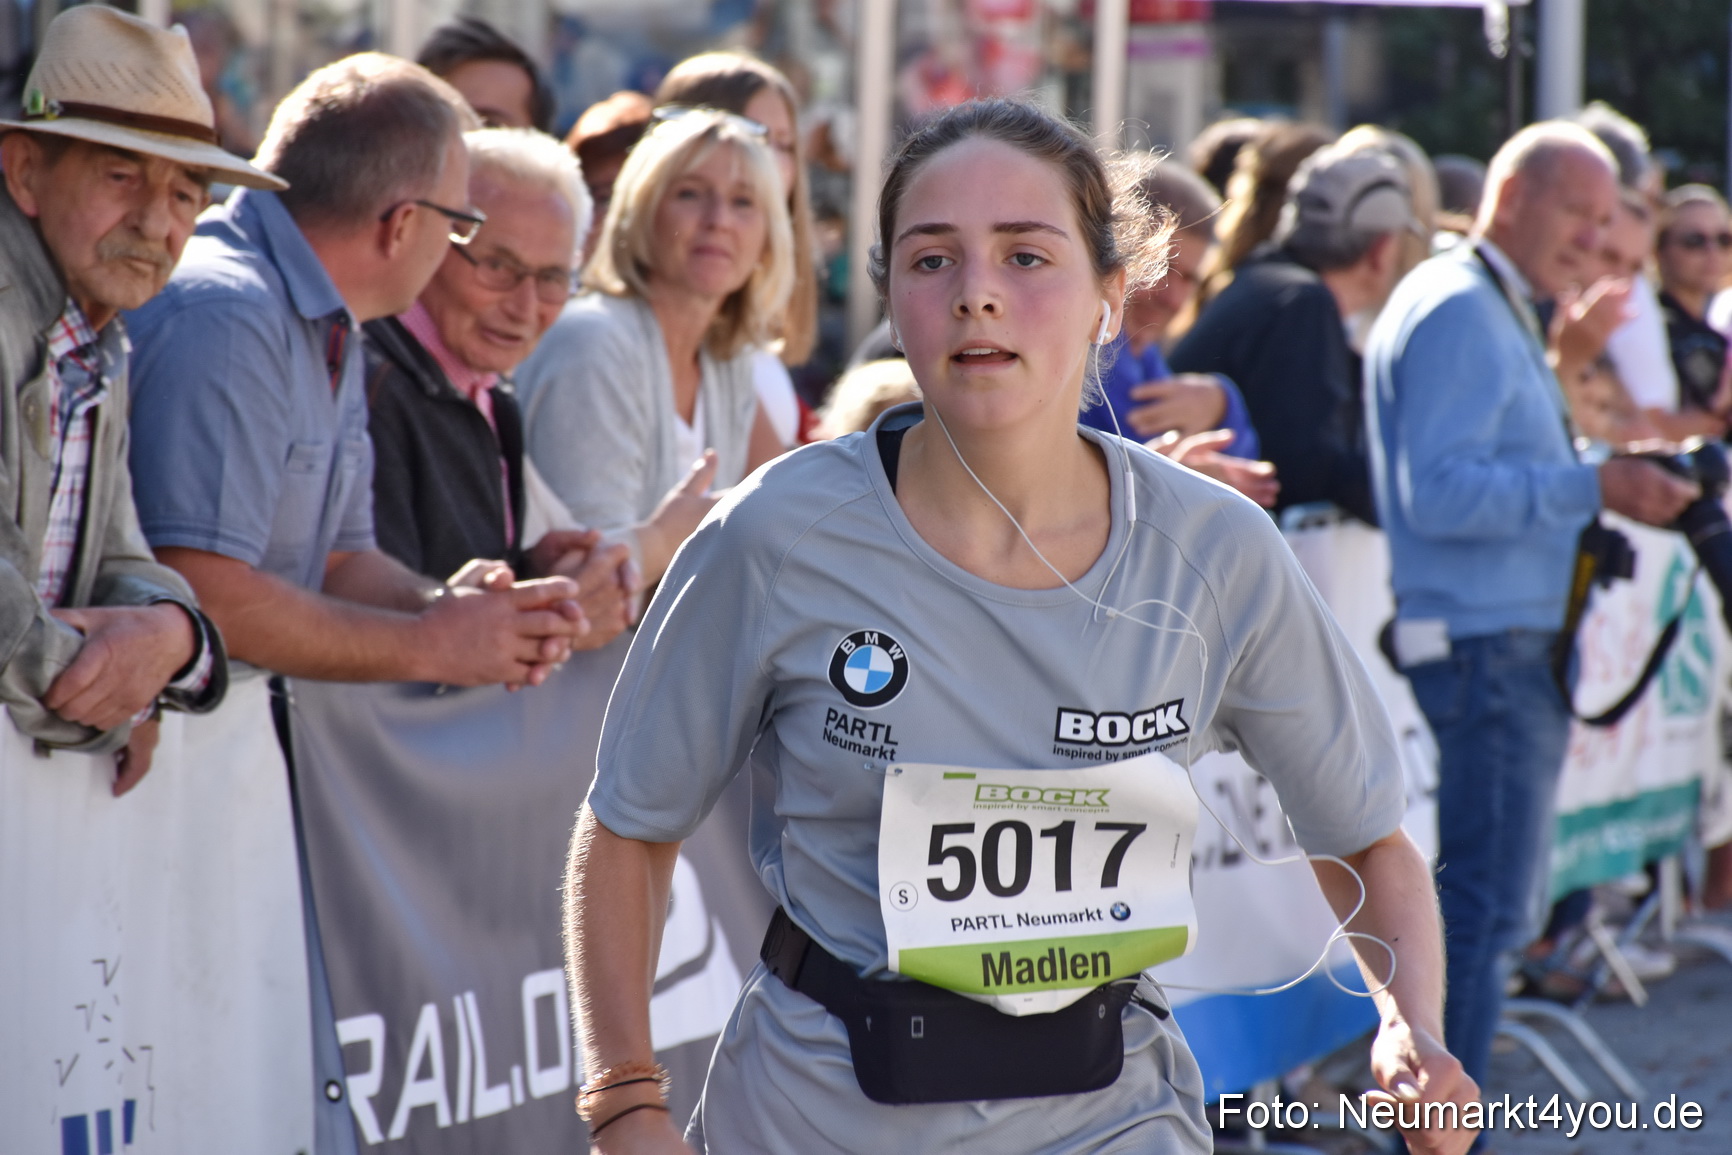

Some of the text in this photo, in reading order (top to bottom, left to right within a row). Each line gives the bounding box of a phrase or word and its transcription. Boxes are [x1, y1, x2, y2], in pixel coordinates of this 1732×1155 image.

[840, 631, 904, 661] BMW
[825, 707, 899, 746] PARTL
[1054, 698, 1190, 747] BOCK
[823, 727, 897, 761] Neumarkt
[1053, 745, 1102, 760] inspired
[1105, 750, 1119, 761] by
[1122, 746, 1152, 760] smart
[973, 802, 1014, 811] inspired
[974, 783, 1110, 807] BOCK
[927, 820, 1147, 902] 5017
[898, 889, 908, 905] S
[951, 907, 1104, 932] PARTL Neumarkt
[982, 947, 1111, 988] Madlen
[336, 967, 584, 1146] RAIL.O
